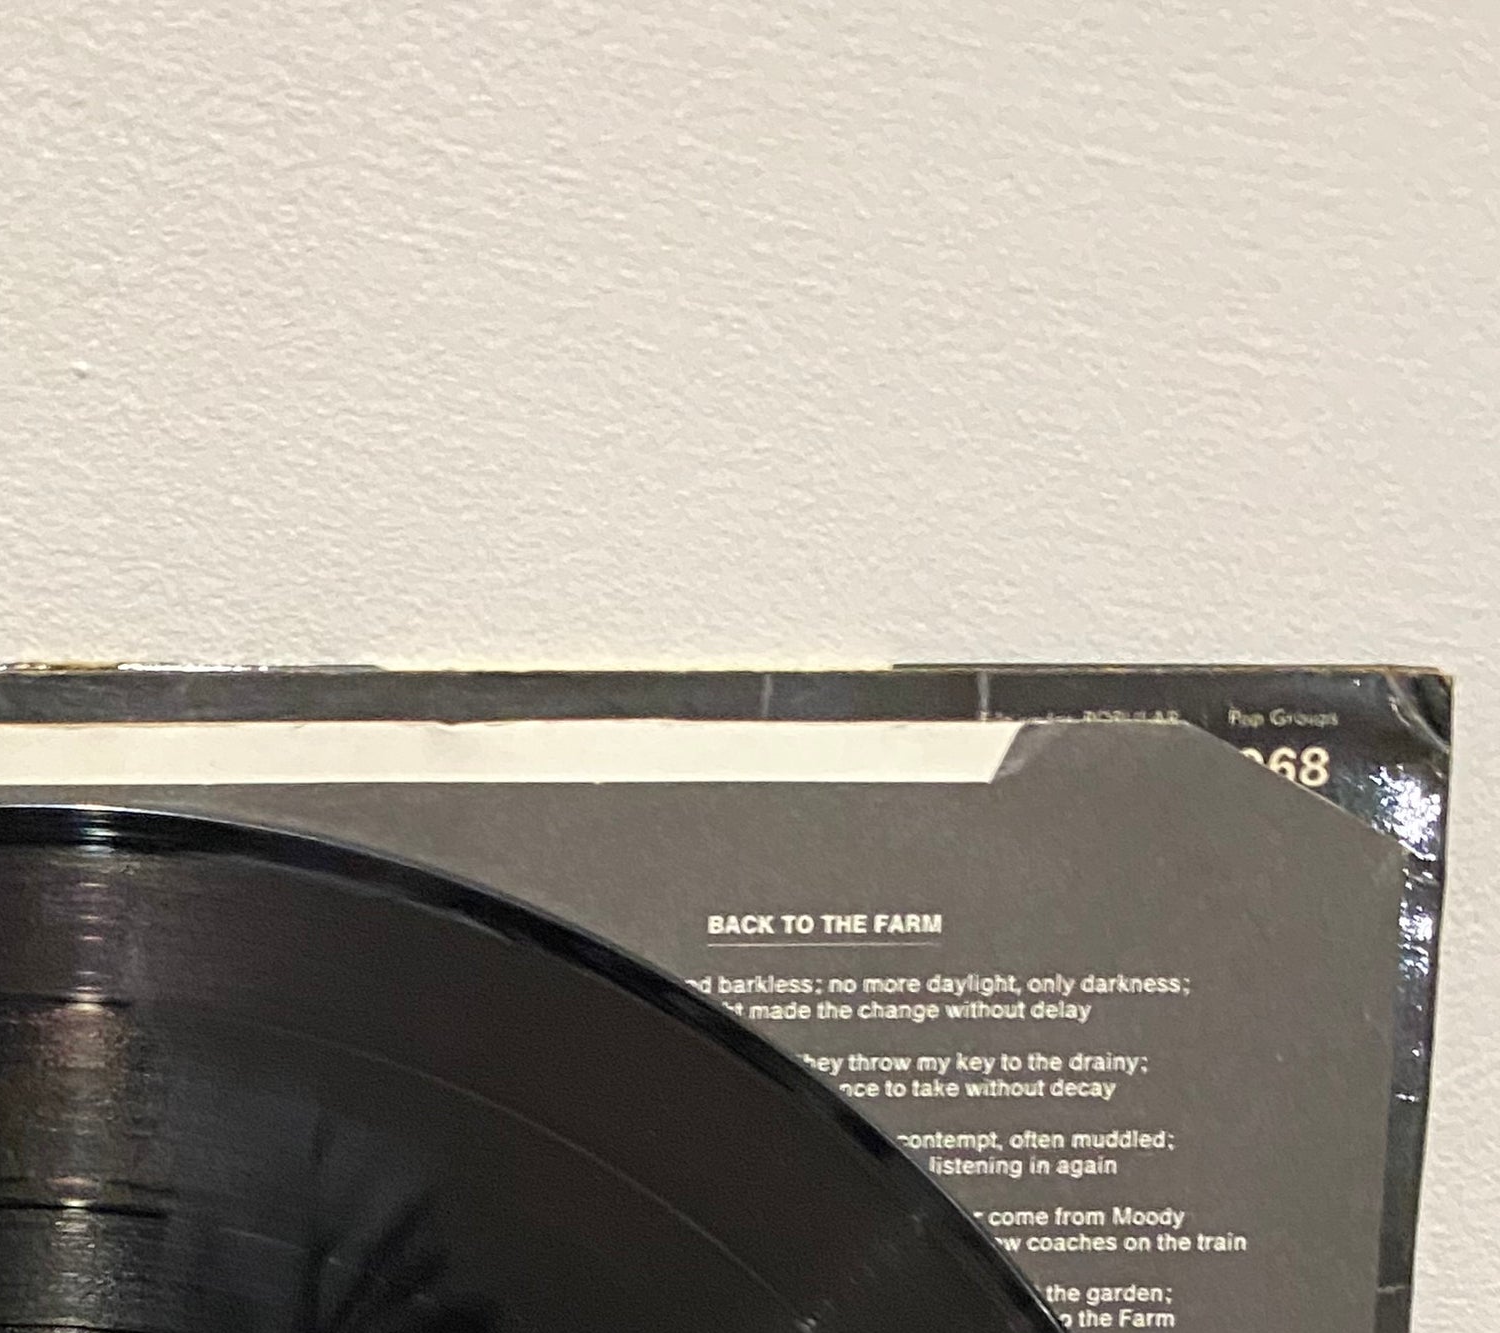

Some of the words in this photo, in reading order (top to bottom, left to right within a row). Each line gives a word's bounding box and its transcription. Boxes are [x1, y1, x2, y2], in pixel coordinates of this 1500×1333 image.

[1237, 745, 1331, 788] 68
[707, 914, 775, 934] BACK
[779, 914, 815, 934] TO
[819, 913, 868, 934] THE
[873, 913, 942, 933] FARM
[717, 974, 822, 995] barkless;
[827, 978, 857, 994] no
[862, 977, 921, 993] more
[925, 974, 1022, 997] daylight,
[1026, 974, 1076, 997] only
[1079, 974, 1190, 995] darkness;
[987, 1210, 1049, 1226] come
[1053, 1206, 1105, 1226] from
[1111, 1206, 1185, 1230] Moody
[1025, 1232, 1118, 1252] coaches
[1123, 1236, 1151, 1251] on
[1156, 1232, 1192, 1252] the
[1196, 1232, 1247, 1252] train
